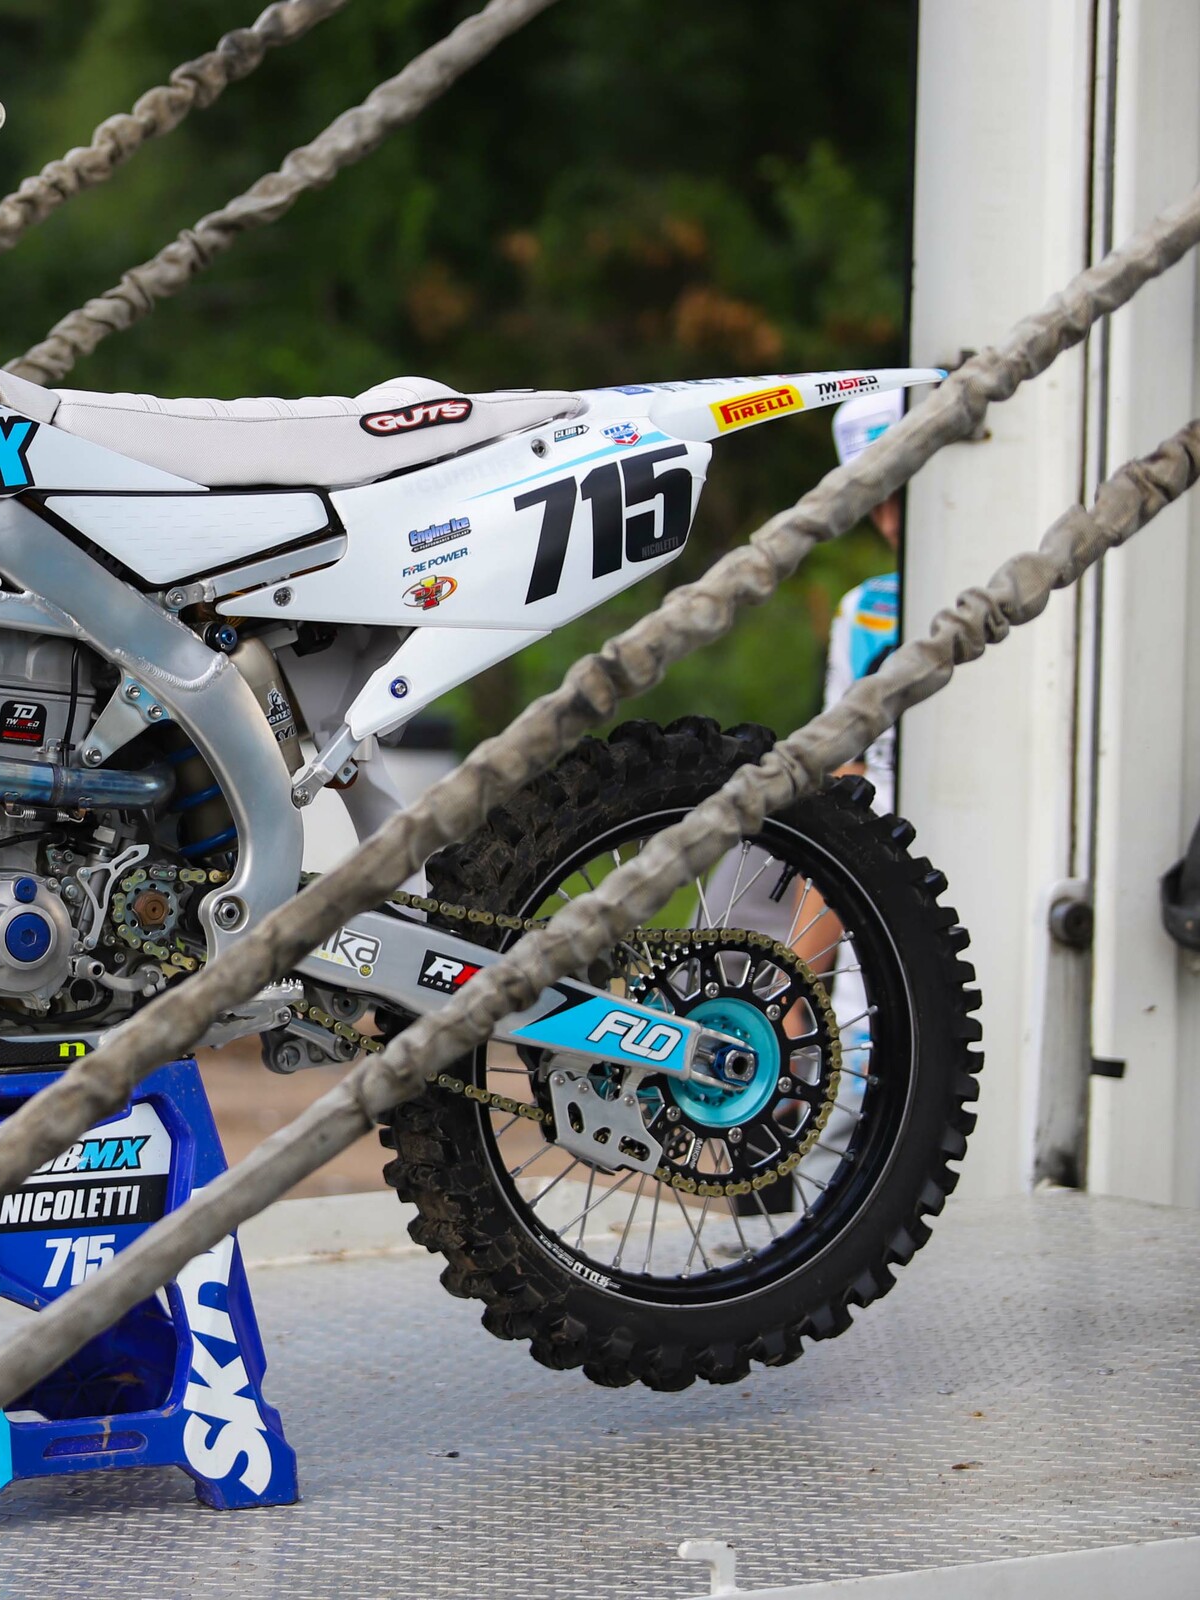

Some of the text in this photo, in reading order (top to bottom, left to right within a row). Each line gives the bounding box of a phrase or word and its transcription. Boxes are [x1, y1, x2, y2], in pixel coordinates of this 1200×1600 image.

[366, 401, 469, 431] GUTS
[718, 387, 795, 425] PIRELLI
[409, 516, 471, 546] Engine Ice
[513, 443, 693, 606] 715
[402, 547, 469, 577] FIRE POWER
[641, 535, 679, 559] NICOLETTI
[585, 1009, 684, 1061] FLO
